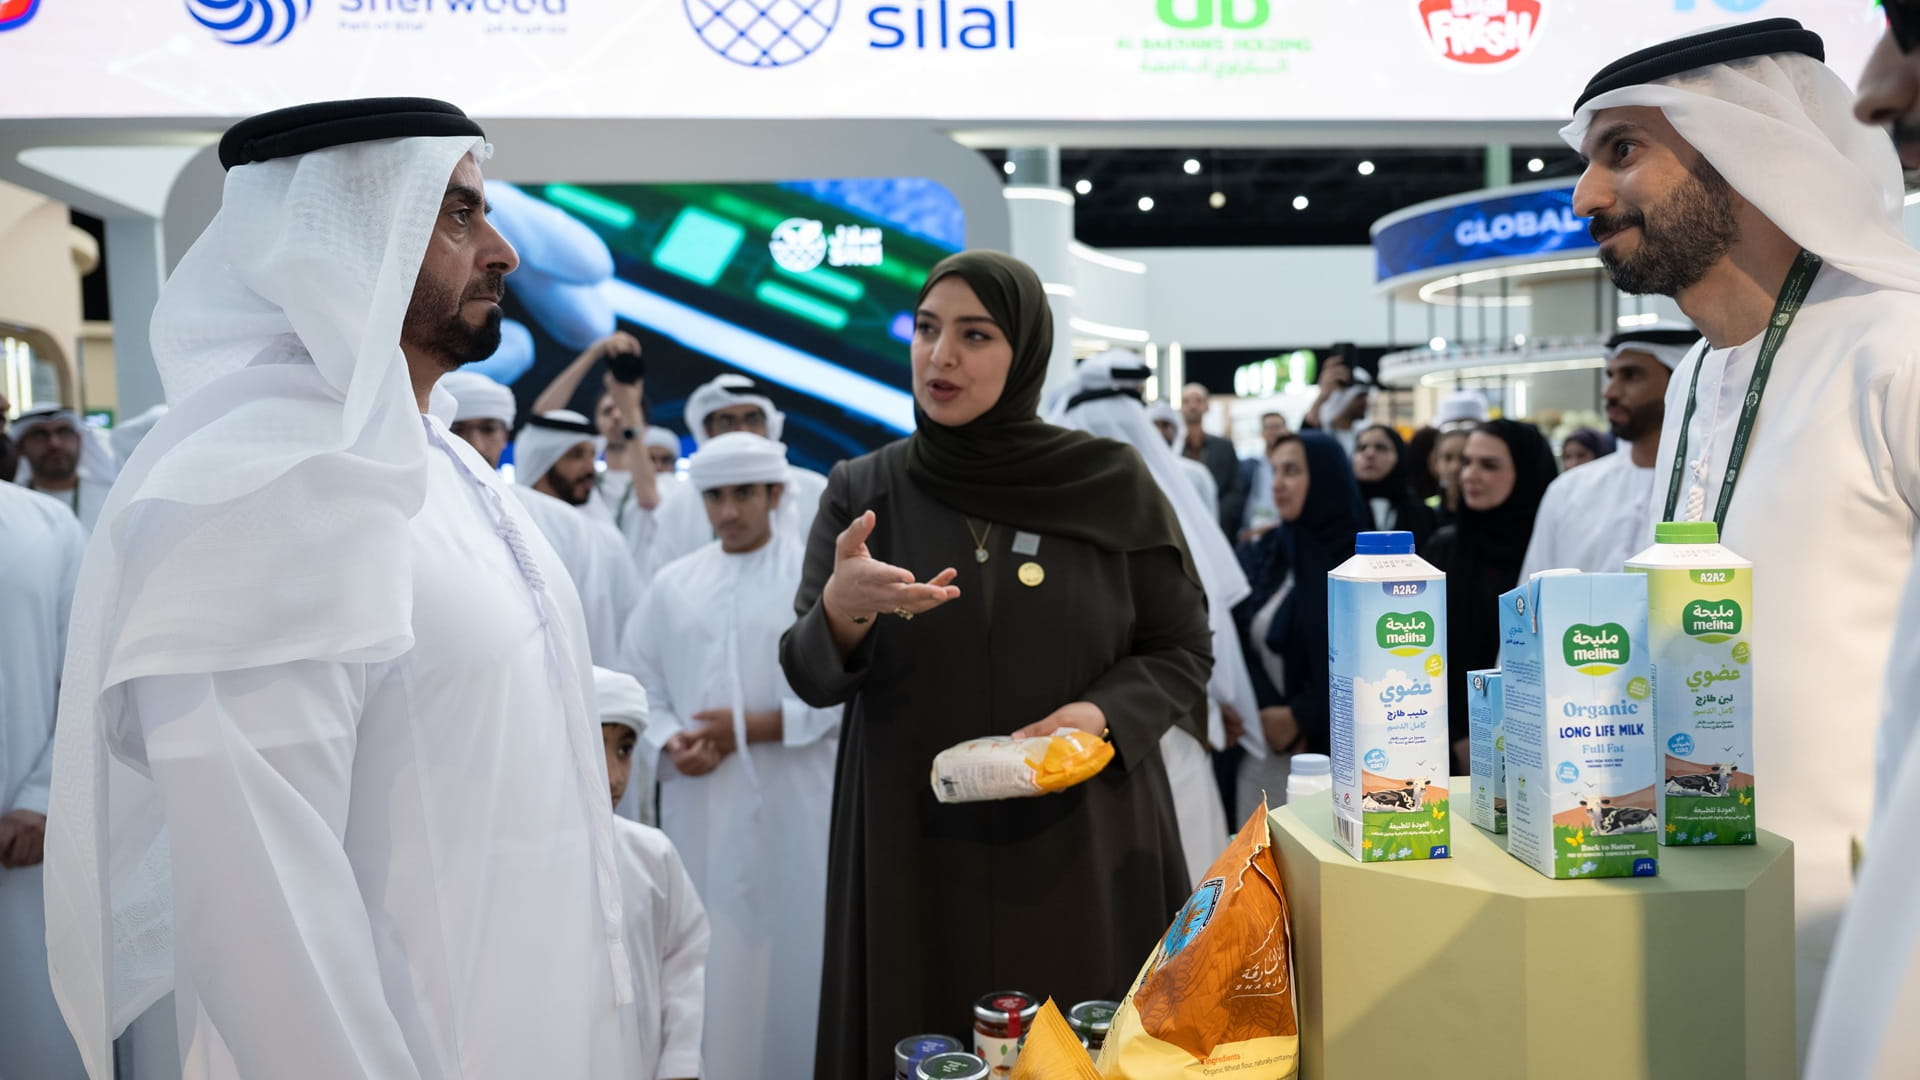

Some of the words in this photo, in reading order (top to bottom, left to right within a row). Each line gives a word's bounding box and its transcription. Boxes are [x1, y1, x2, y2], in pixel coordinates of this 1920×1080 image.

[867, 0, 1016, 49] silal
[1455, 206, 1583, 246] GLOBAL
[1700, 572, 1726, 583] A2A2
[1392, 584, 1418, 595] A2A2
[1692, 604, 1734, 620] مليحة
[1385, 617, 1426, 633] مليحة
[1693, 620, 1734, 631] meliha
[1386, 632, 1426, 644] meliha
[1572, 629, 1619, 647] مليحة
[1573, 648, 1620, 661] meliha
[1686, 663, 1741, 693] عضوي
[1379, 678, 1433, 707] عضوي
[1695, 694, 1717, 706] طازج
[1718, 693, 1734, 705] لبن
[1387, 709, 1406, 721] طازج
[1407, 708, 1428, 719] حليب
[1563, 699, 1638, 719] Organic
[1559, 726, 1591, 739] LONG
[1595, 724, 1616, 737] LIFE
[1619, 722, 1645, 737] MILK
[1582, 743, 1605, 754] Full
[1607, 742, 1625, 753] Fat
[1581, 844, 1600, 852] Back
